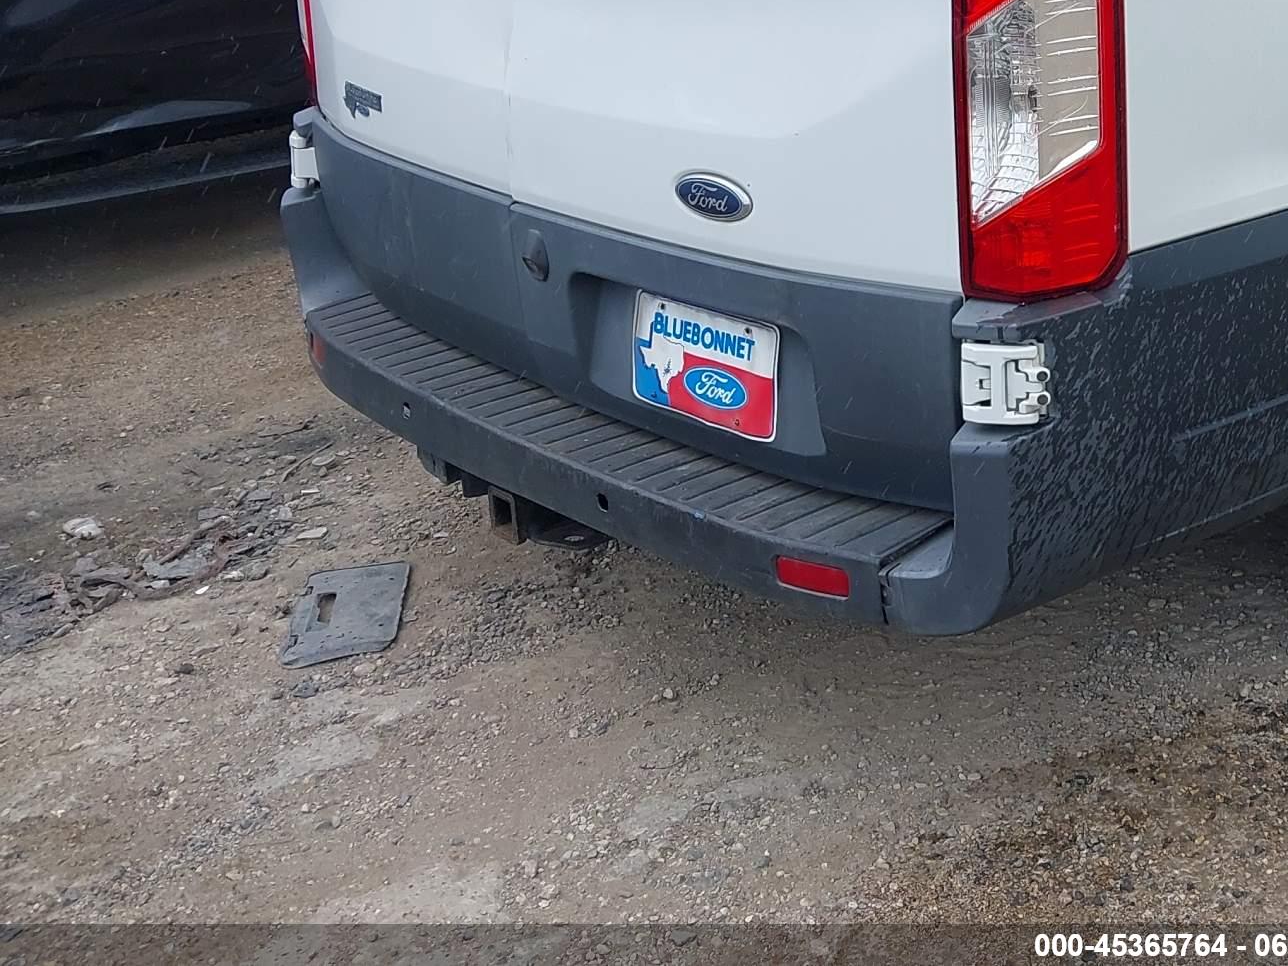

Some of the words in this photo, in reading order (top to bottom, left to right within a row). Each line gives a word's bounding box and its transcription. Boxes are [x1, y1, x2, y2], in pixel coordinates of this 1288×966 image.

[687, 182, 728, 212] Ford
[653, 311, 755, 362] BLUEBONNET
[695, 372, 737, 405] Ford
